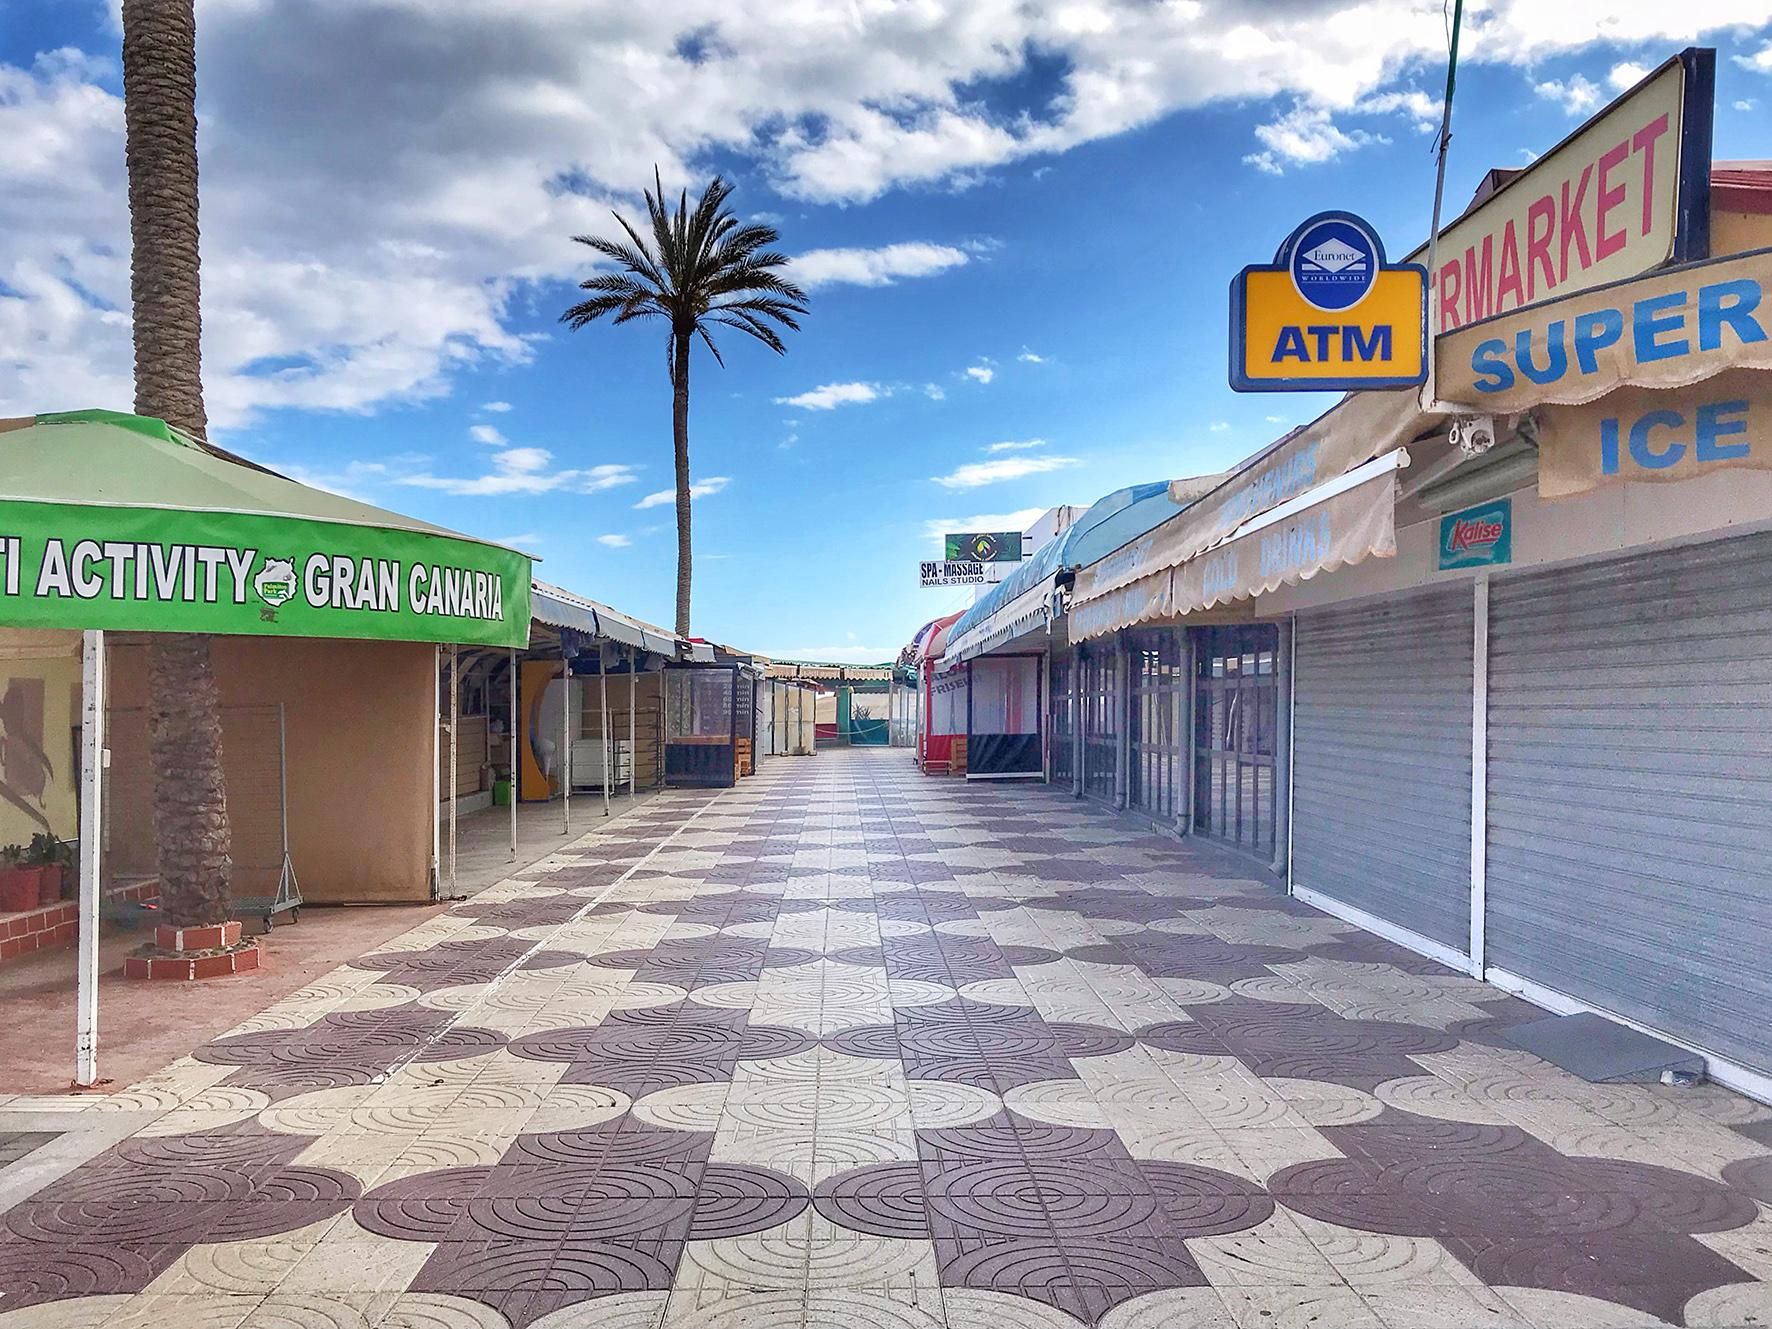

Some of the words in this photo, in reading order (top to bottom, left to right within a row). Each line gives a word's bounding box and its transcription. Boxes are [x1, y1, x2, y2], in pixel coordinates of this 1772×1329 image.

[1314, 250, 1356, 261] Euronet
[1271, 324, 1393, 363] ATM
[1471, 278, 1769, 393] SUPER
[1600, 399, 1751, 476] ICE
[1452, 519, 1503, 551] Kalise
[36, 539, 258, 605] ACTIVITY
[303, 552, 401, 613] GRAN
[408, 563, 504, 622] CANARIA
[921, 562, 938, 578] SPA
[944, 562, 984, 577] MASSAGE
[922, 577, 949, 586] NAILS
[951, 576, 984, 585] STUDIO
